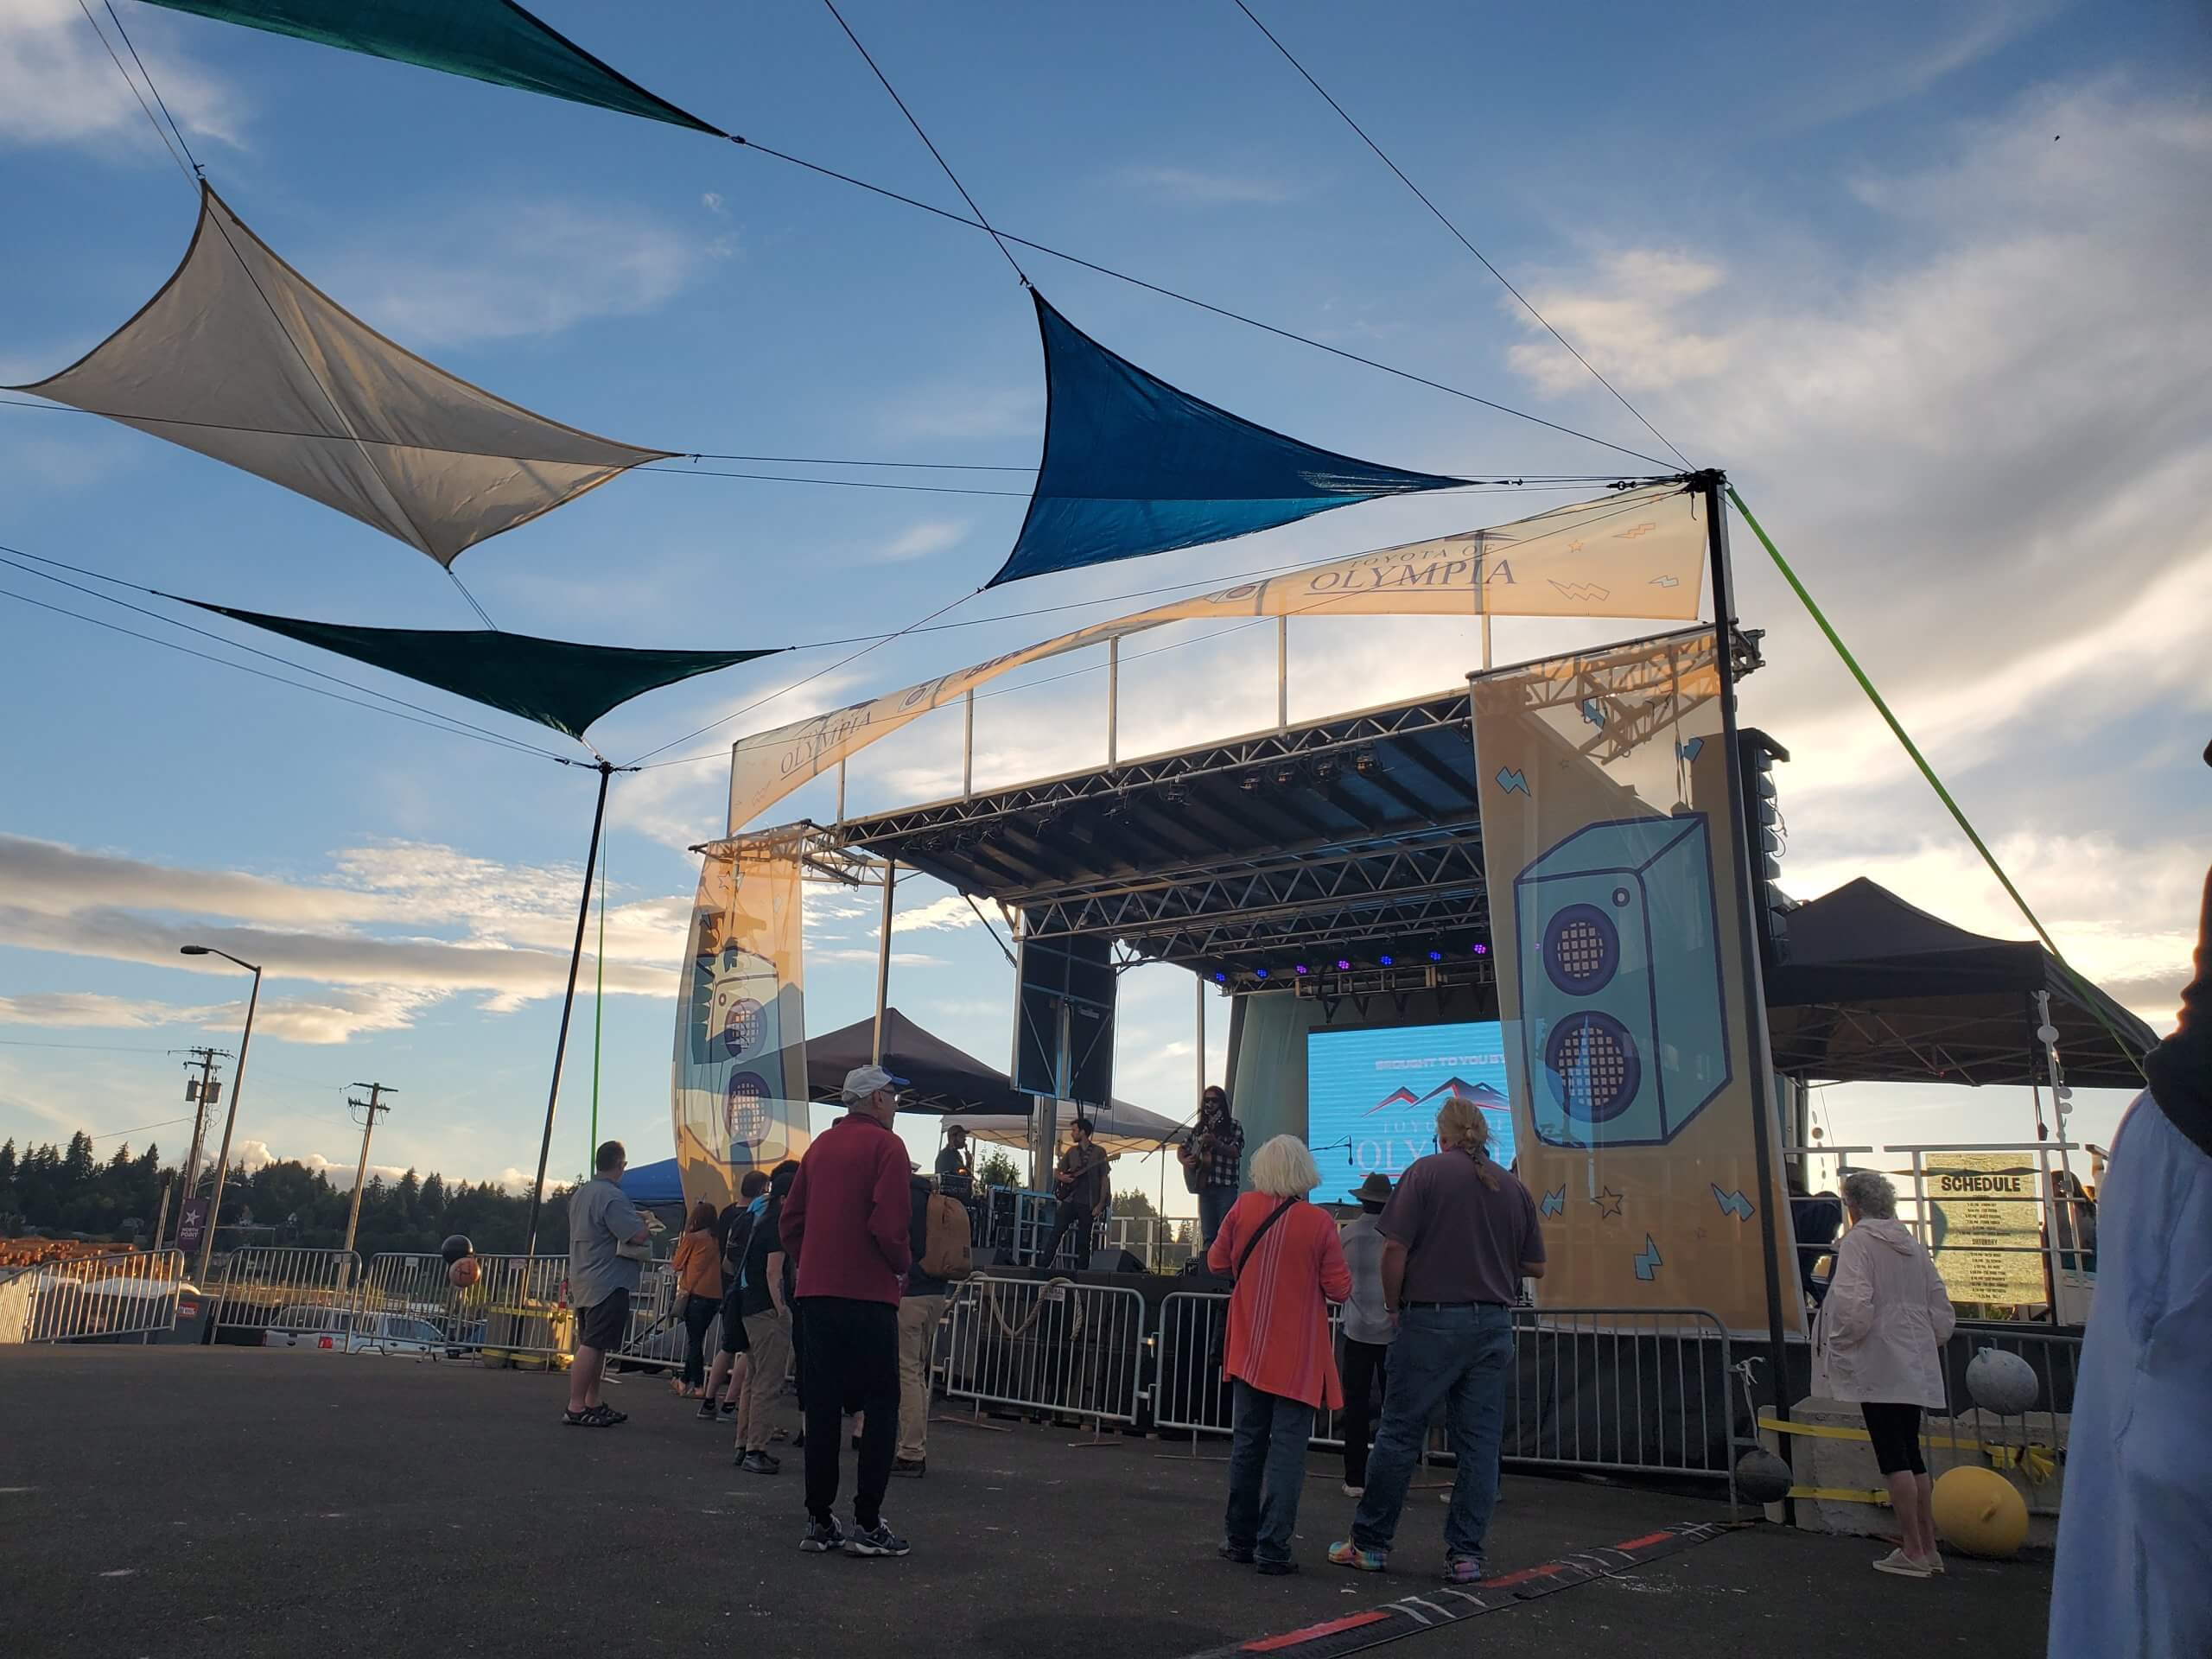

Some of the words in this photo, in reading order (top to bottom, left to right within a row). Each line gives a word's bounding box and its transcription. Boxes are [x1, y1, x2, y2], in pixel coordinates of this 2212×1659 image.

[1350, 548, 1448, 568] TOYOTA
[1461, 543, 1496, 556] OF
[1310, 559, 1517, 591] OLYMPIA
[781, 711, 872, 773] OLYMPIA
[1438, 1057, 1458, 1065] TO
[1459, 1054, 1488, 1065] YOU
[1941, 1176, 2021, 1192] SCHEDULE
